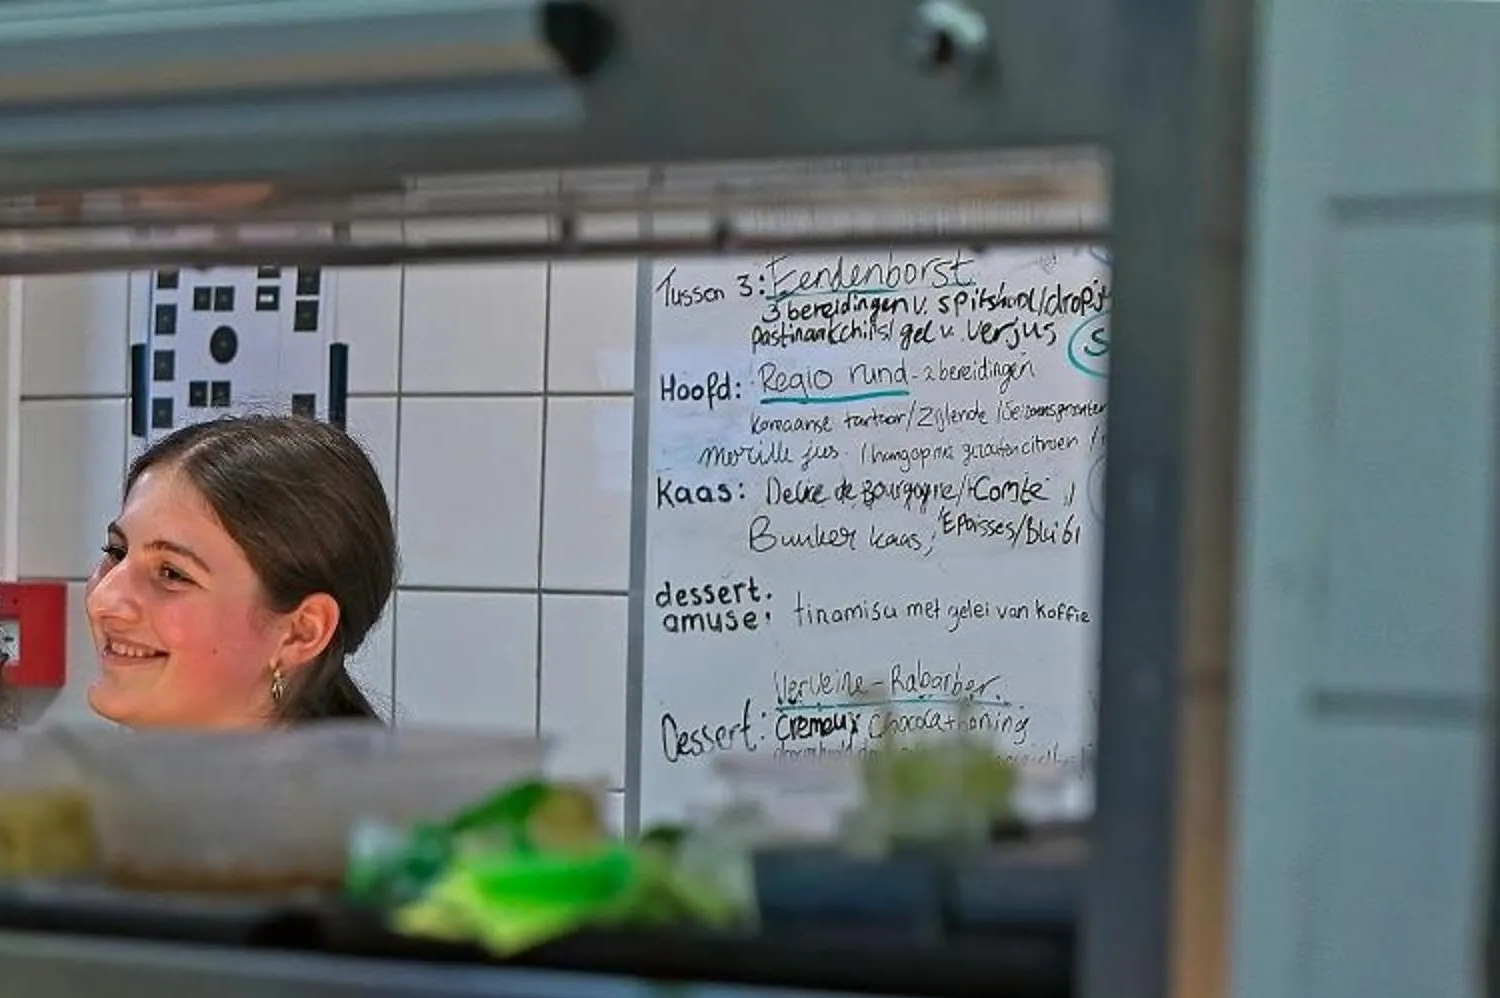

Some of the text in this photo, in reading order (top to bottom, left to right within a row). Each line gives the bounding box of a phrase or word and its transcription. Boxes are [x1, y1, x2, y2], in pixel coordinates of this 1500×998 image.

[736, 272, 766, 298] 3:
[660, 371, 742, 410] Hoofd:
[758, 361, 833, 398] Regio
[657, 475, 746, 508] Kaas:
[906, 598, 940, 620] met
[947, 598, 990, 634] gelei
[996, 604, 1029, 620] van
[1035, 598, 1092, 623] koffie
